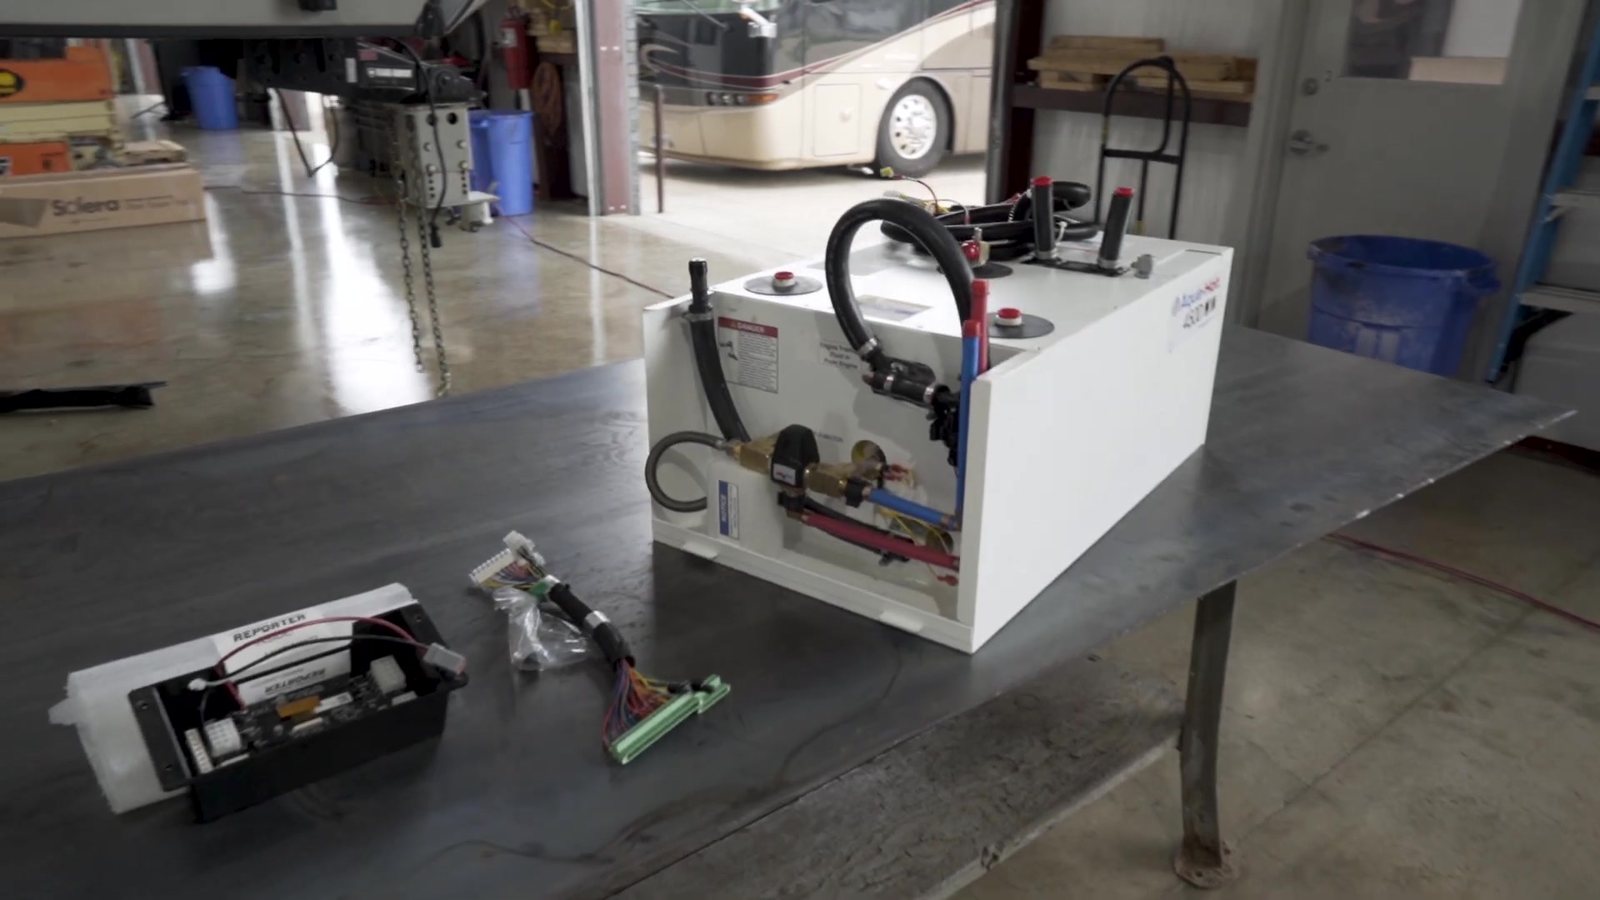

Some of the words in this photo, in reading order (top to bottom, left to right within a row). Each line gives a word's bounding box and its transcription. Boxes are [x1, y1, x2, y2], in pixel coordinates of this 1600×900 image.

[53, 196, 120, 216] Solera
[737, 321, 765, 333] DANGER
[233, 614, 306, 642] REPORTER
